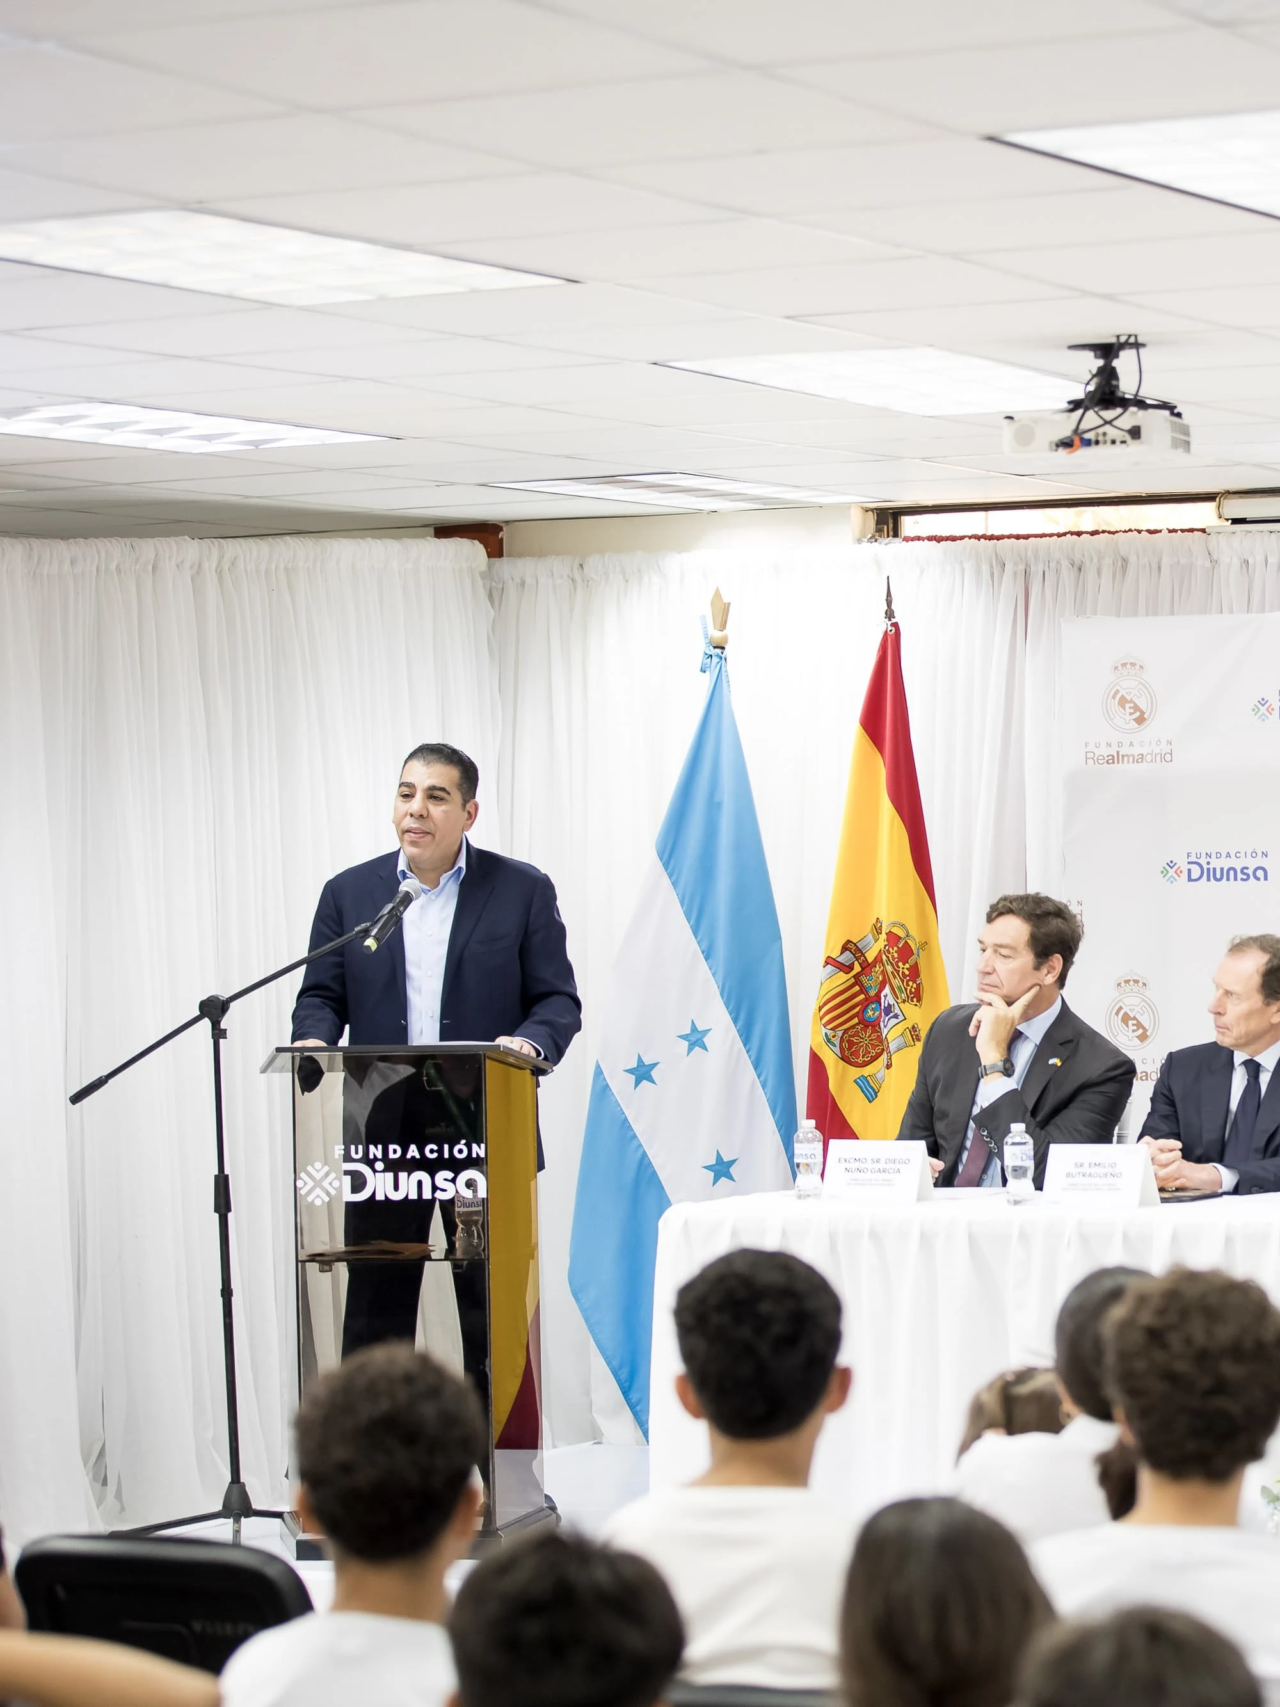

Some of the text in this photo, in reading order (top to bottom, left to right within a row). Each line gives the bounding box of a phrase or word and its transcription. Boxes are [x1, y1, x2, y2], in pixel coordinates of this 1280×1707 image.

[1085, 738, 1173, 749] FUNDACIÓN
[1085, 748, 1173, 766] Realmadrid
[1186, 849, 1269, 860] FUNDACIÓN
[1186, 860, 1269, 883] Diunsa
[333, 1139, 486, 1160] FUNDACIÓN
[342, 1160, 488, 1202] Diunsa
